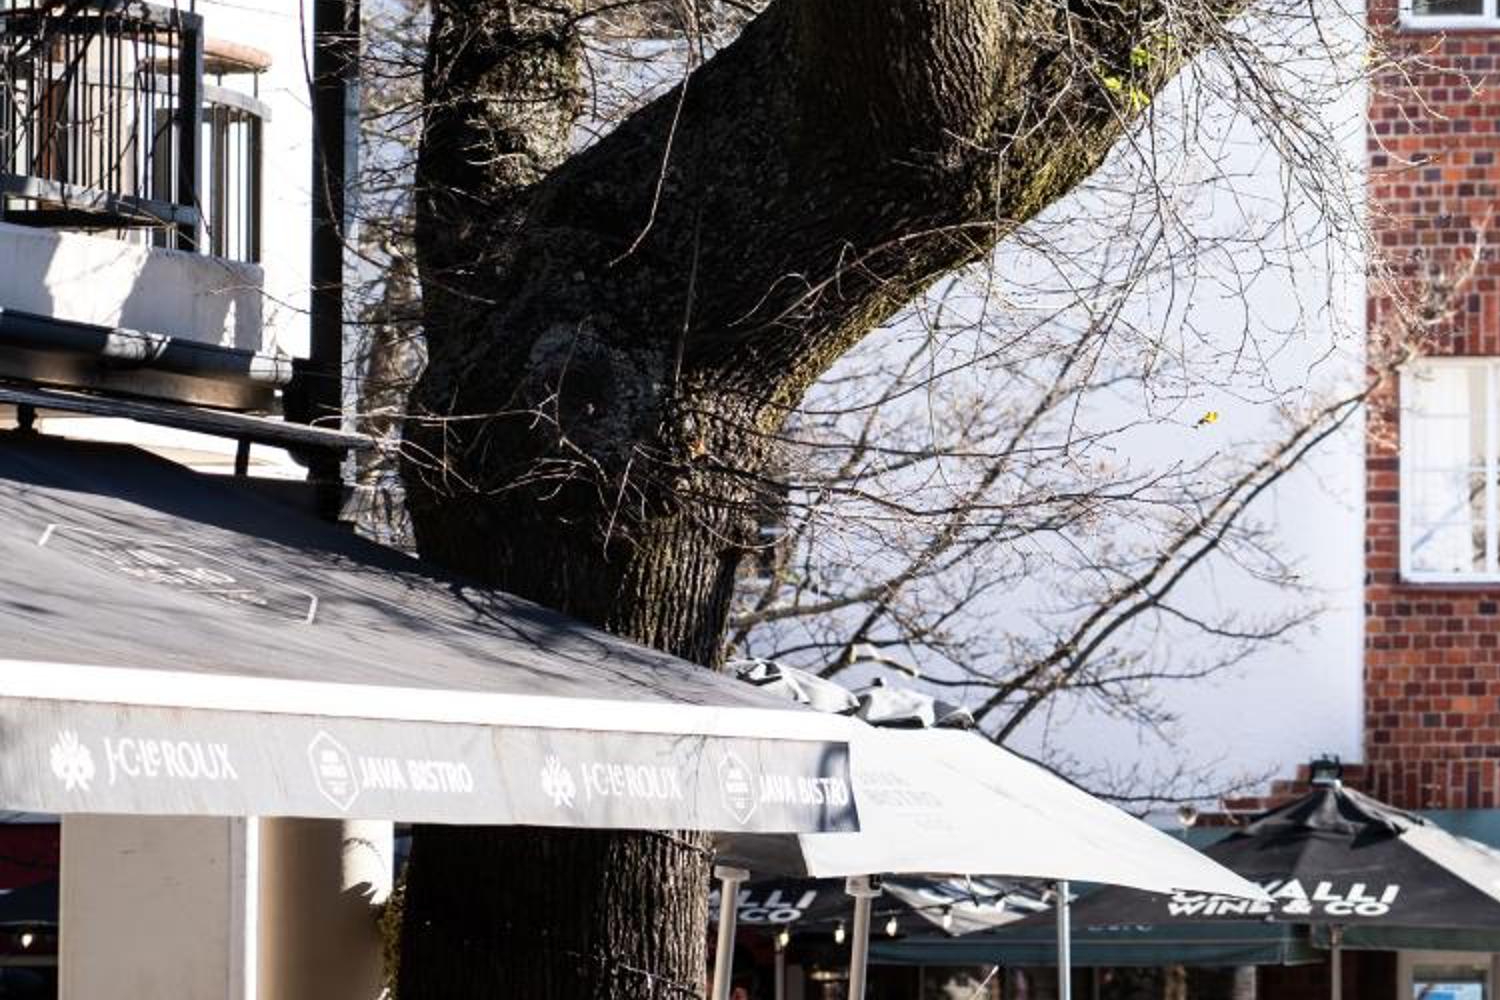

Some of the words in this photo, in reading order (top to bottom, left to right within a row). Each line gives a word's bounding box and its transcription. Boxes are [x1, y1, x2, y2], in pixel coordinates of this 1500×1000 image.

[357, 756, 406, 789] JAVA
[406, 760, 474, 793] BISTRO
[759, 775, 796, 803] JAVA
[799, 777, 848, 807] BISTRO
[1324, 900, 1389, 916] CO
